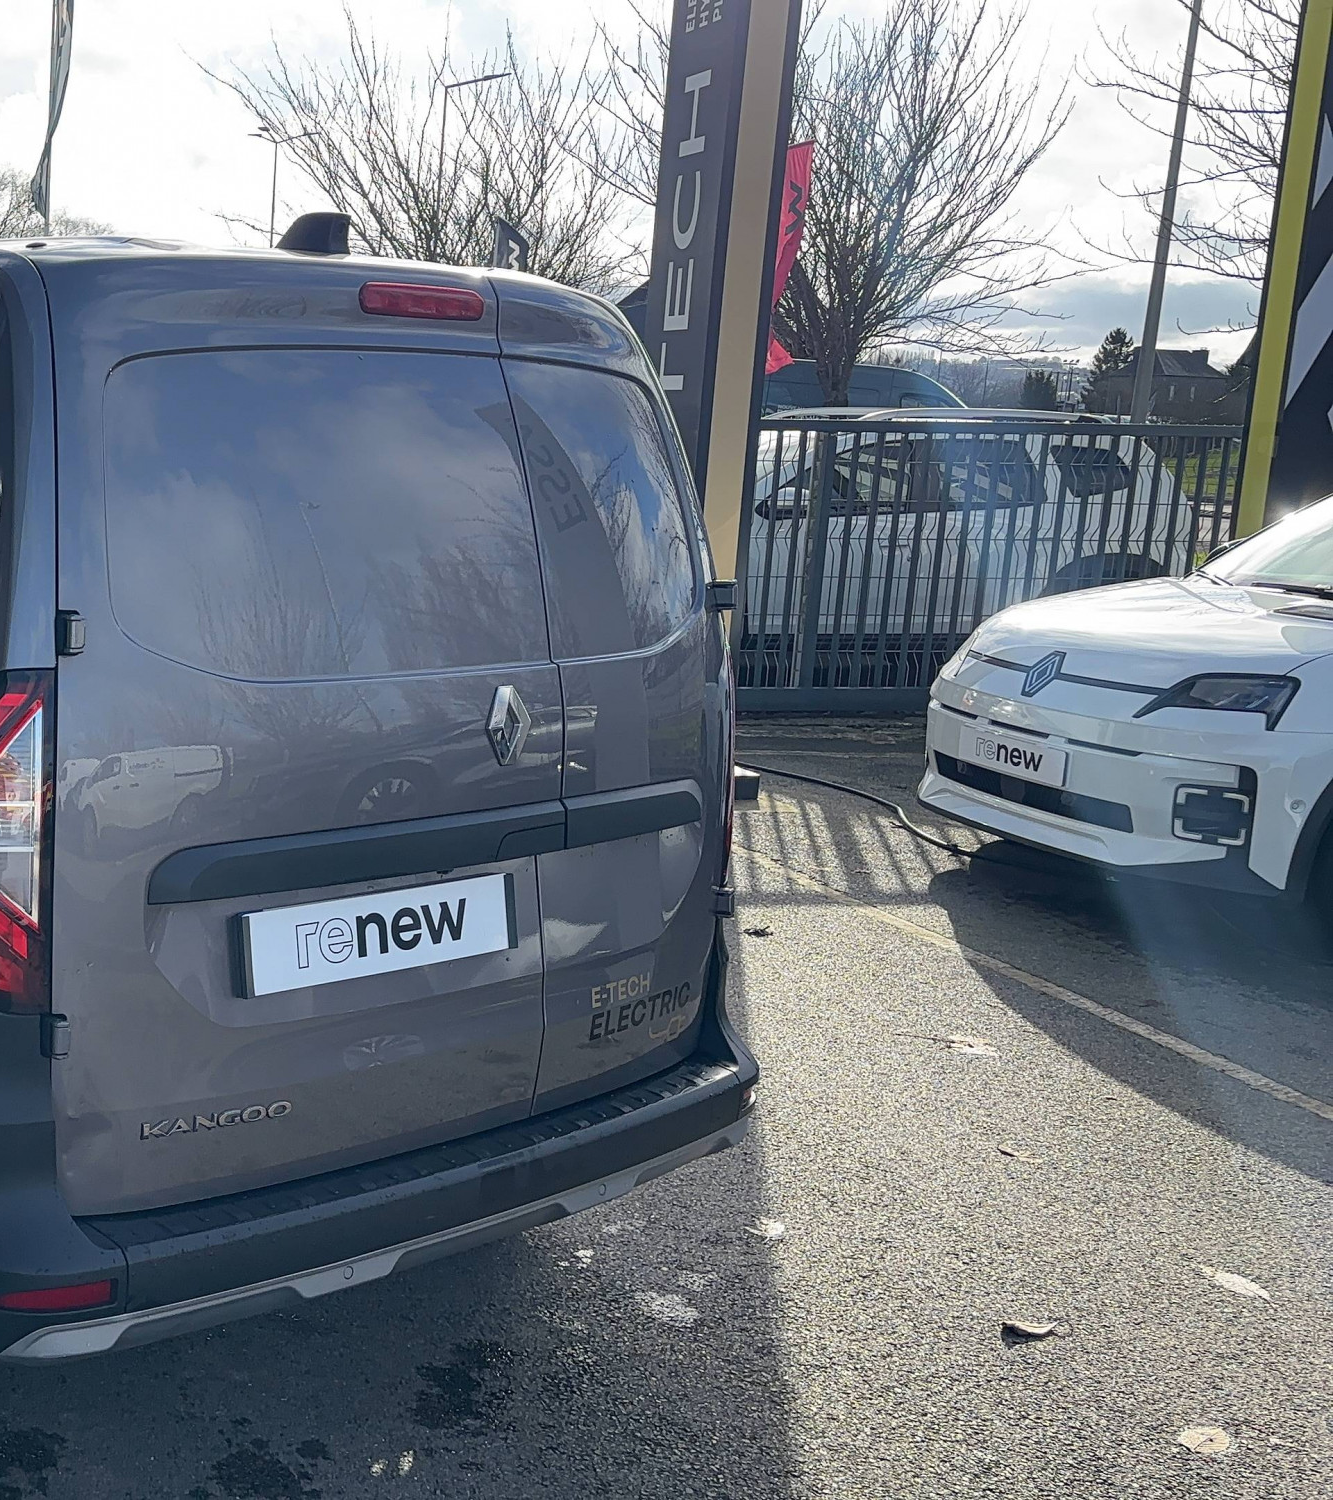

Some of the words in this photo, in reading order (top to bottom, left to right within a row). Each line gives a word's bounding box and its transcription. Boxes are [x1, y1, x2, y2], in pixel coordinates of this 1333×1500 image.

[975, 736, 1043, 773] renew
[295, 897, 467, 970] renew
[591, 971, 651, 1009] E-TECH
[588, 981, 691, 1042] ELECTRIC
[140, 1100, 293, 1140] KANGOO
